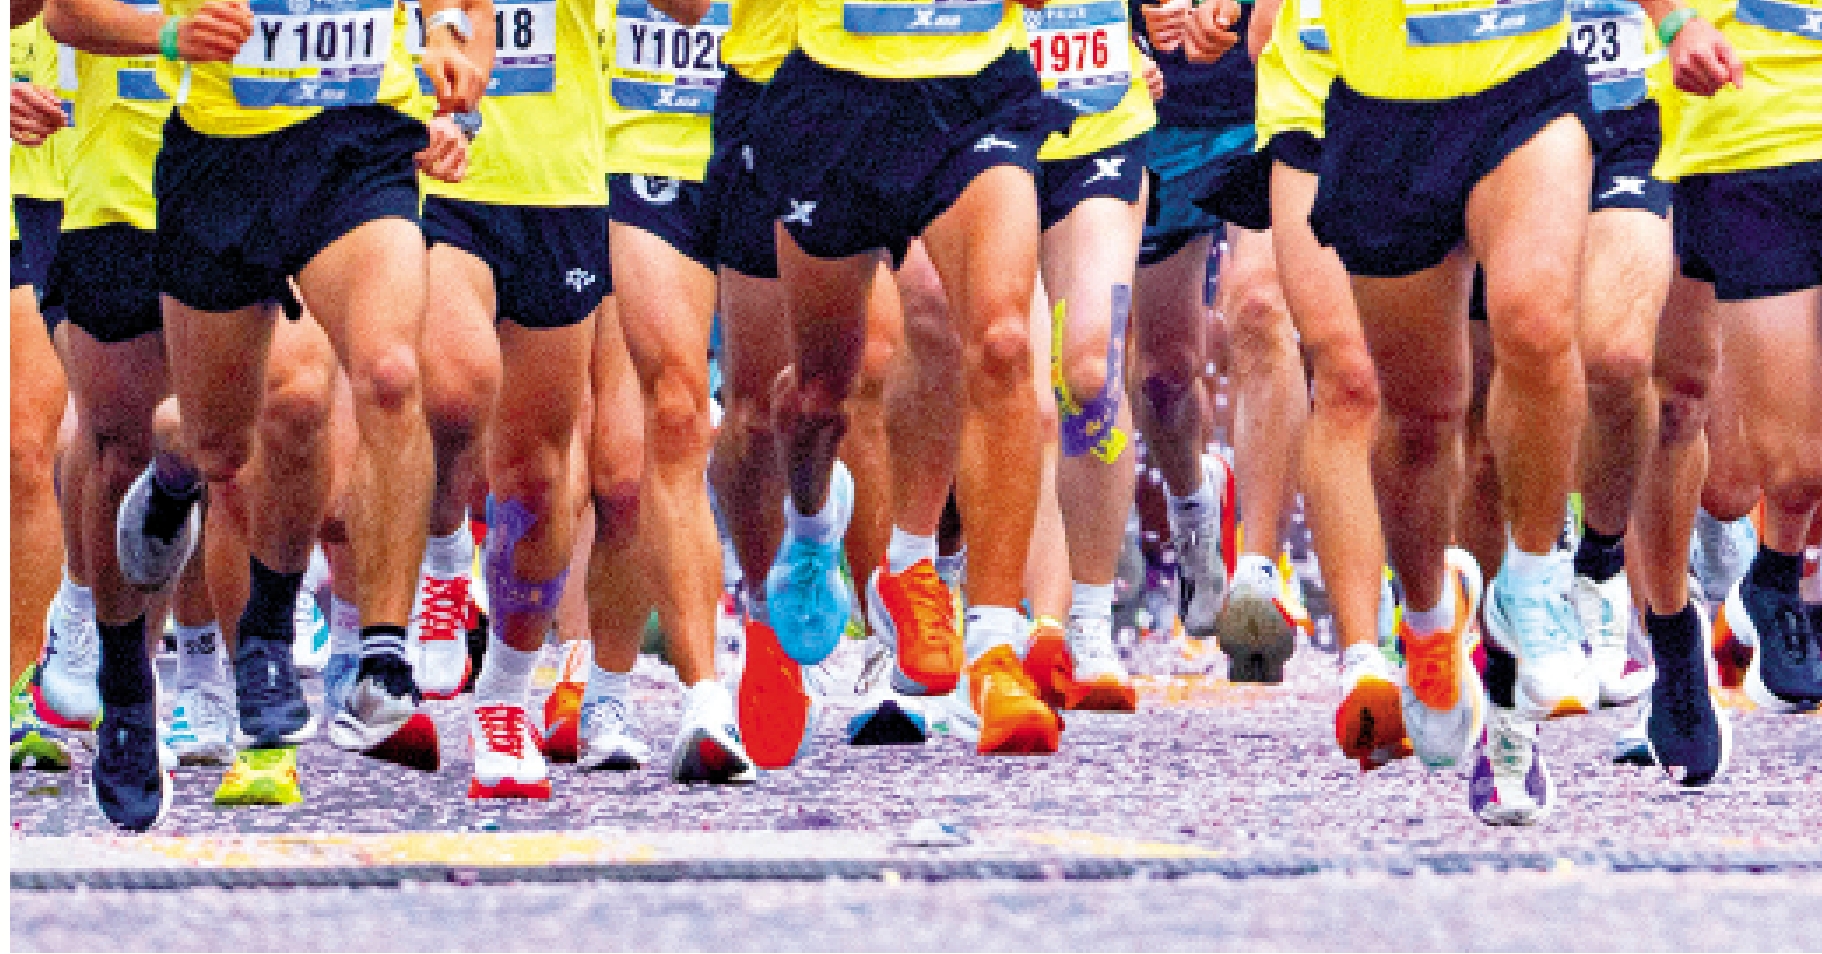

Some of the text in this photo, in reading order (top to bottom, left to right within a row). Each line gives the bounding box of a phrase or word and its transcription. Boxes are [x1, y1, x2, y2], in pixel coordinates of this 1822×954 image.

[259, 17, 376, 62] Y1011
[1030, 30, 1108, 72] 1976
[1567, 21, 1621, 64] 23
